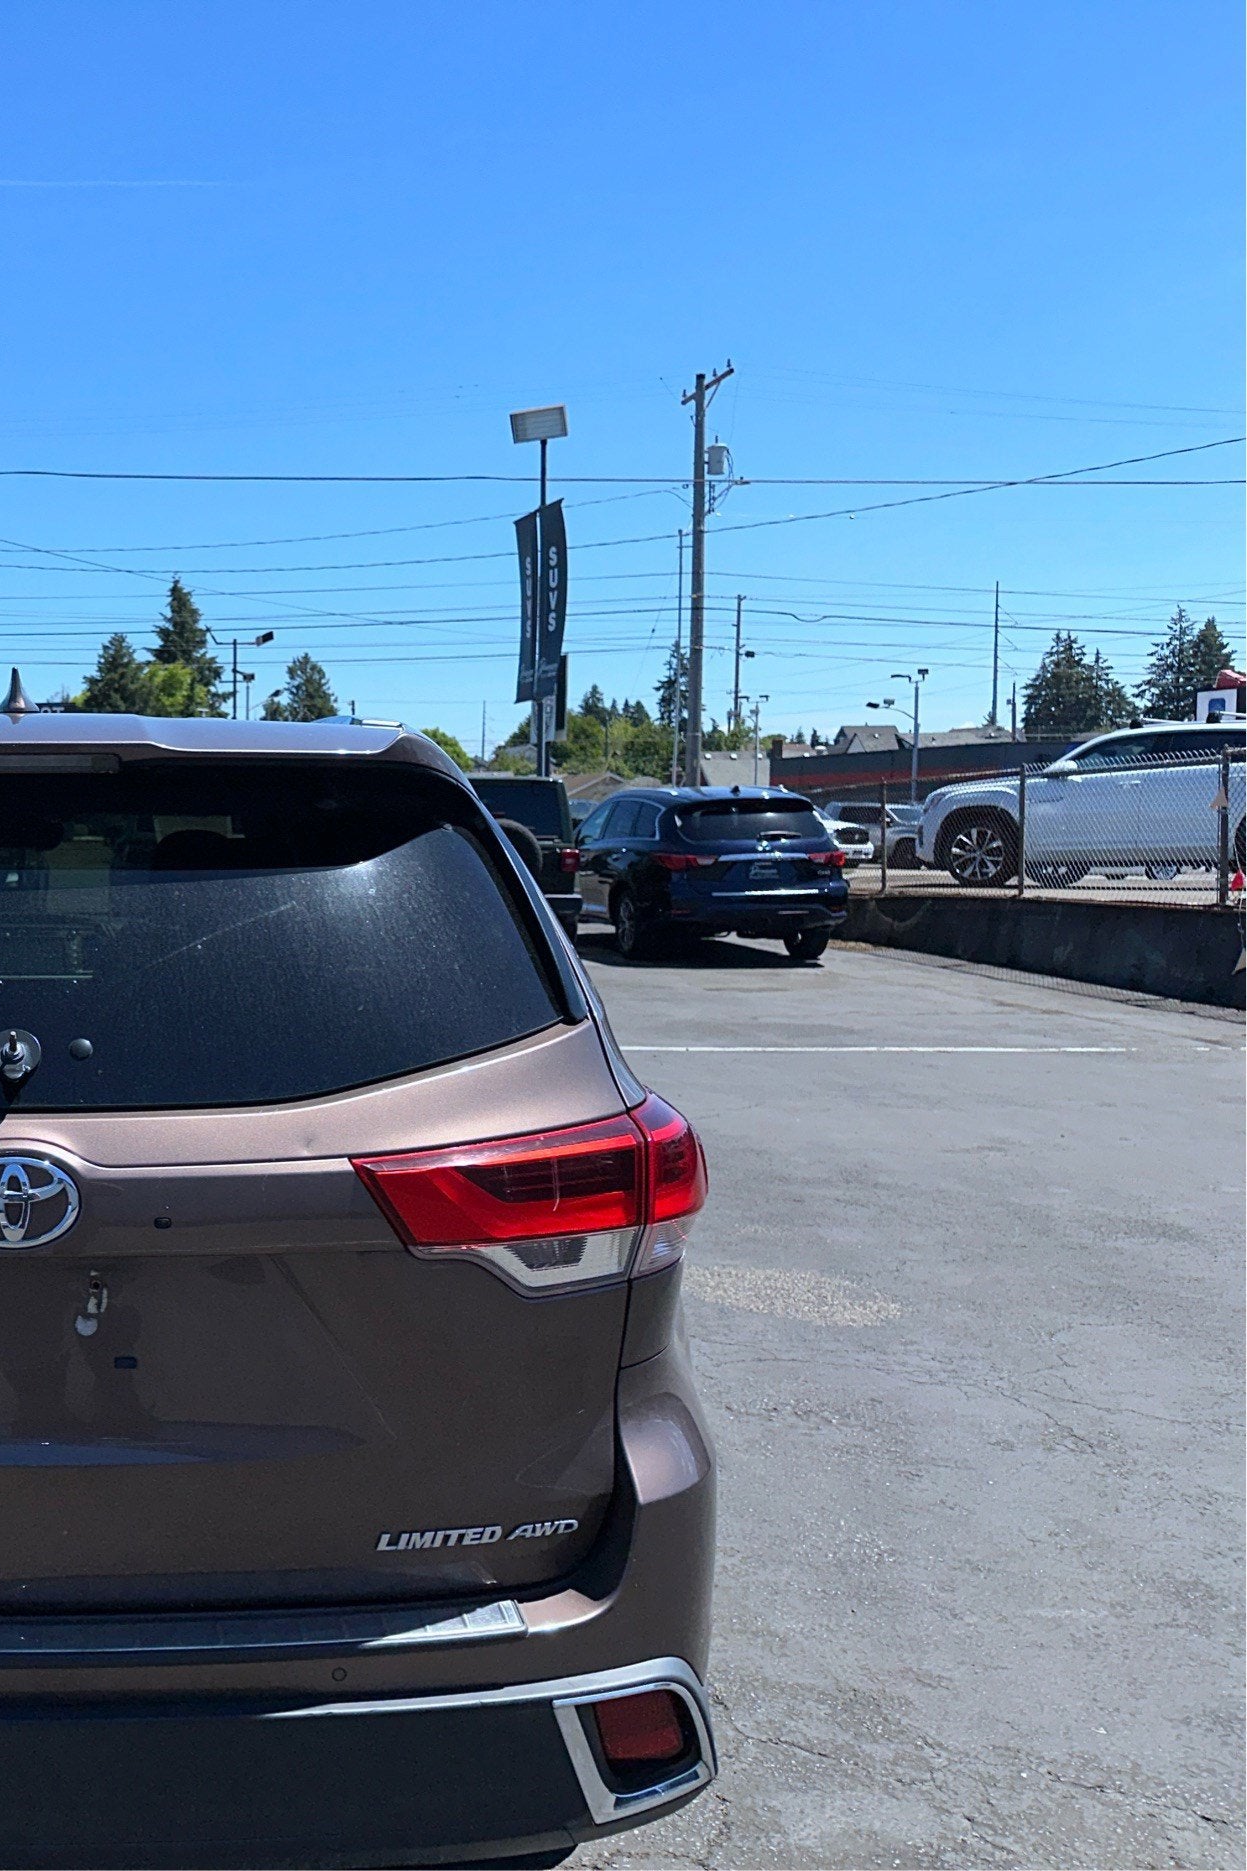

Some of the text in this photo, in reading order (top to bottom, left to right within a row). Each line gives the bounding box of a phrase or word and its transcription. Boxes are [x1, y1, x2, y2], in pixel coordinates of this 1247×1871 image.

[548, 546, 558, 632] SUVS
[376, 1519, 579, 1551] LIMITED AWD
